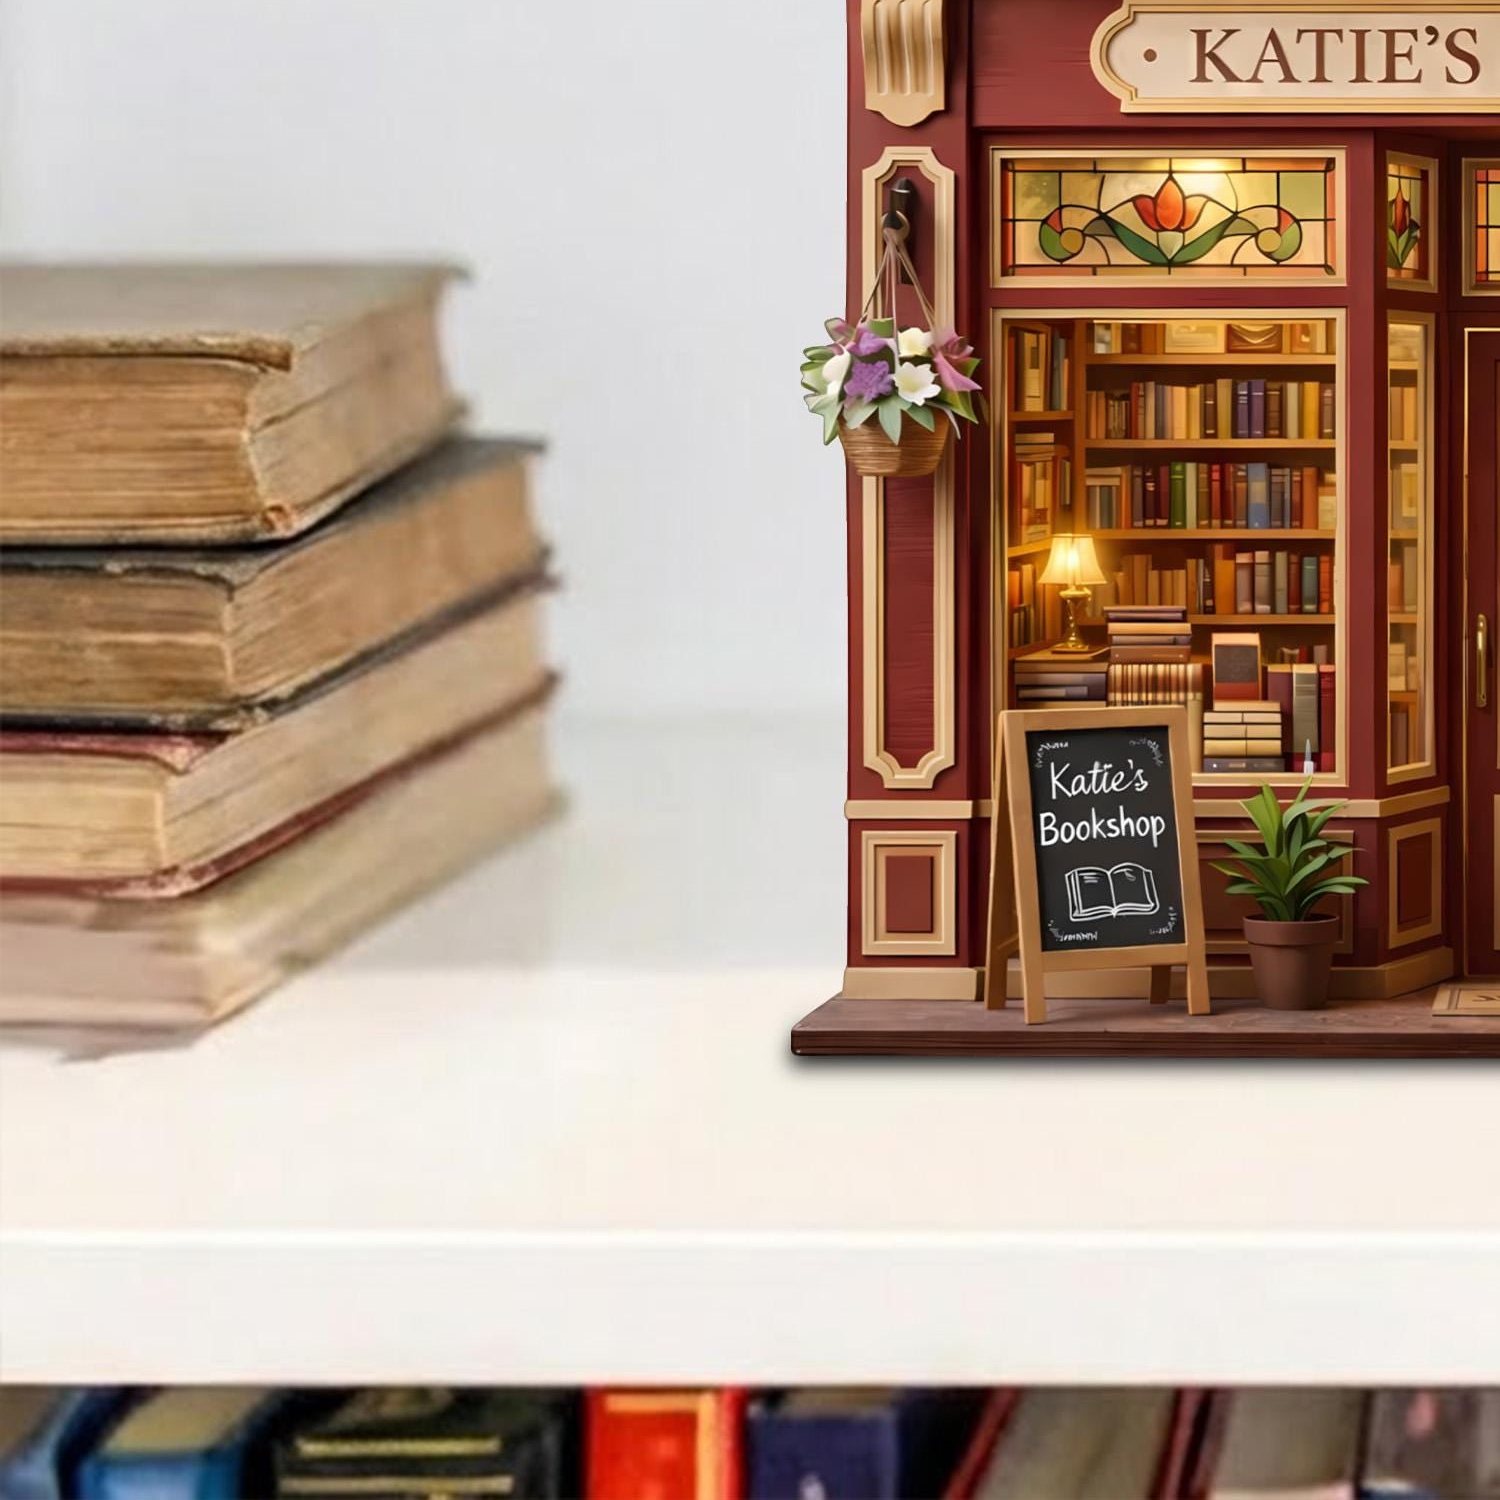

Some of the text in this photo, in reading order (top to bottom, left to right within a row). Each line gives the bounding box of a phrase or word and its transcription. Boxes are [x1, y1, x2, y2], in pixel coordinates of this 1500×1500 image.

[1189, 25, 1481, 84] KATIE'S
[1050, 759, 1149, 799] Katie's
[1039, 805, 1166, 848] Bookshop
